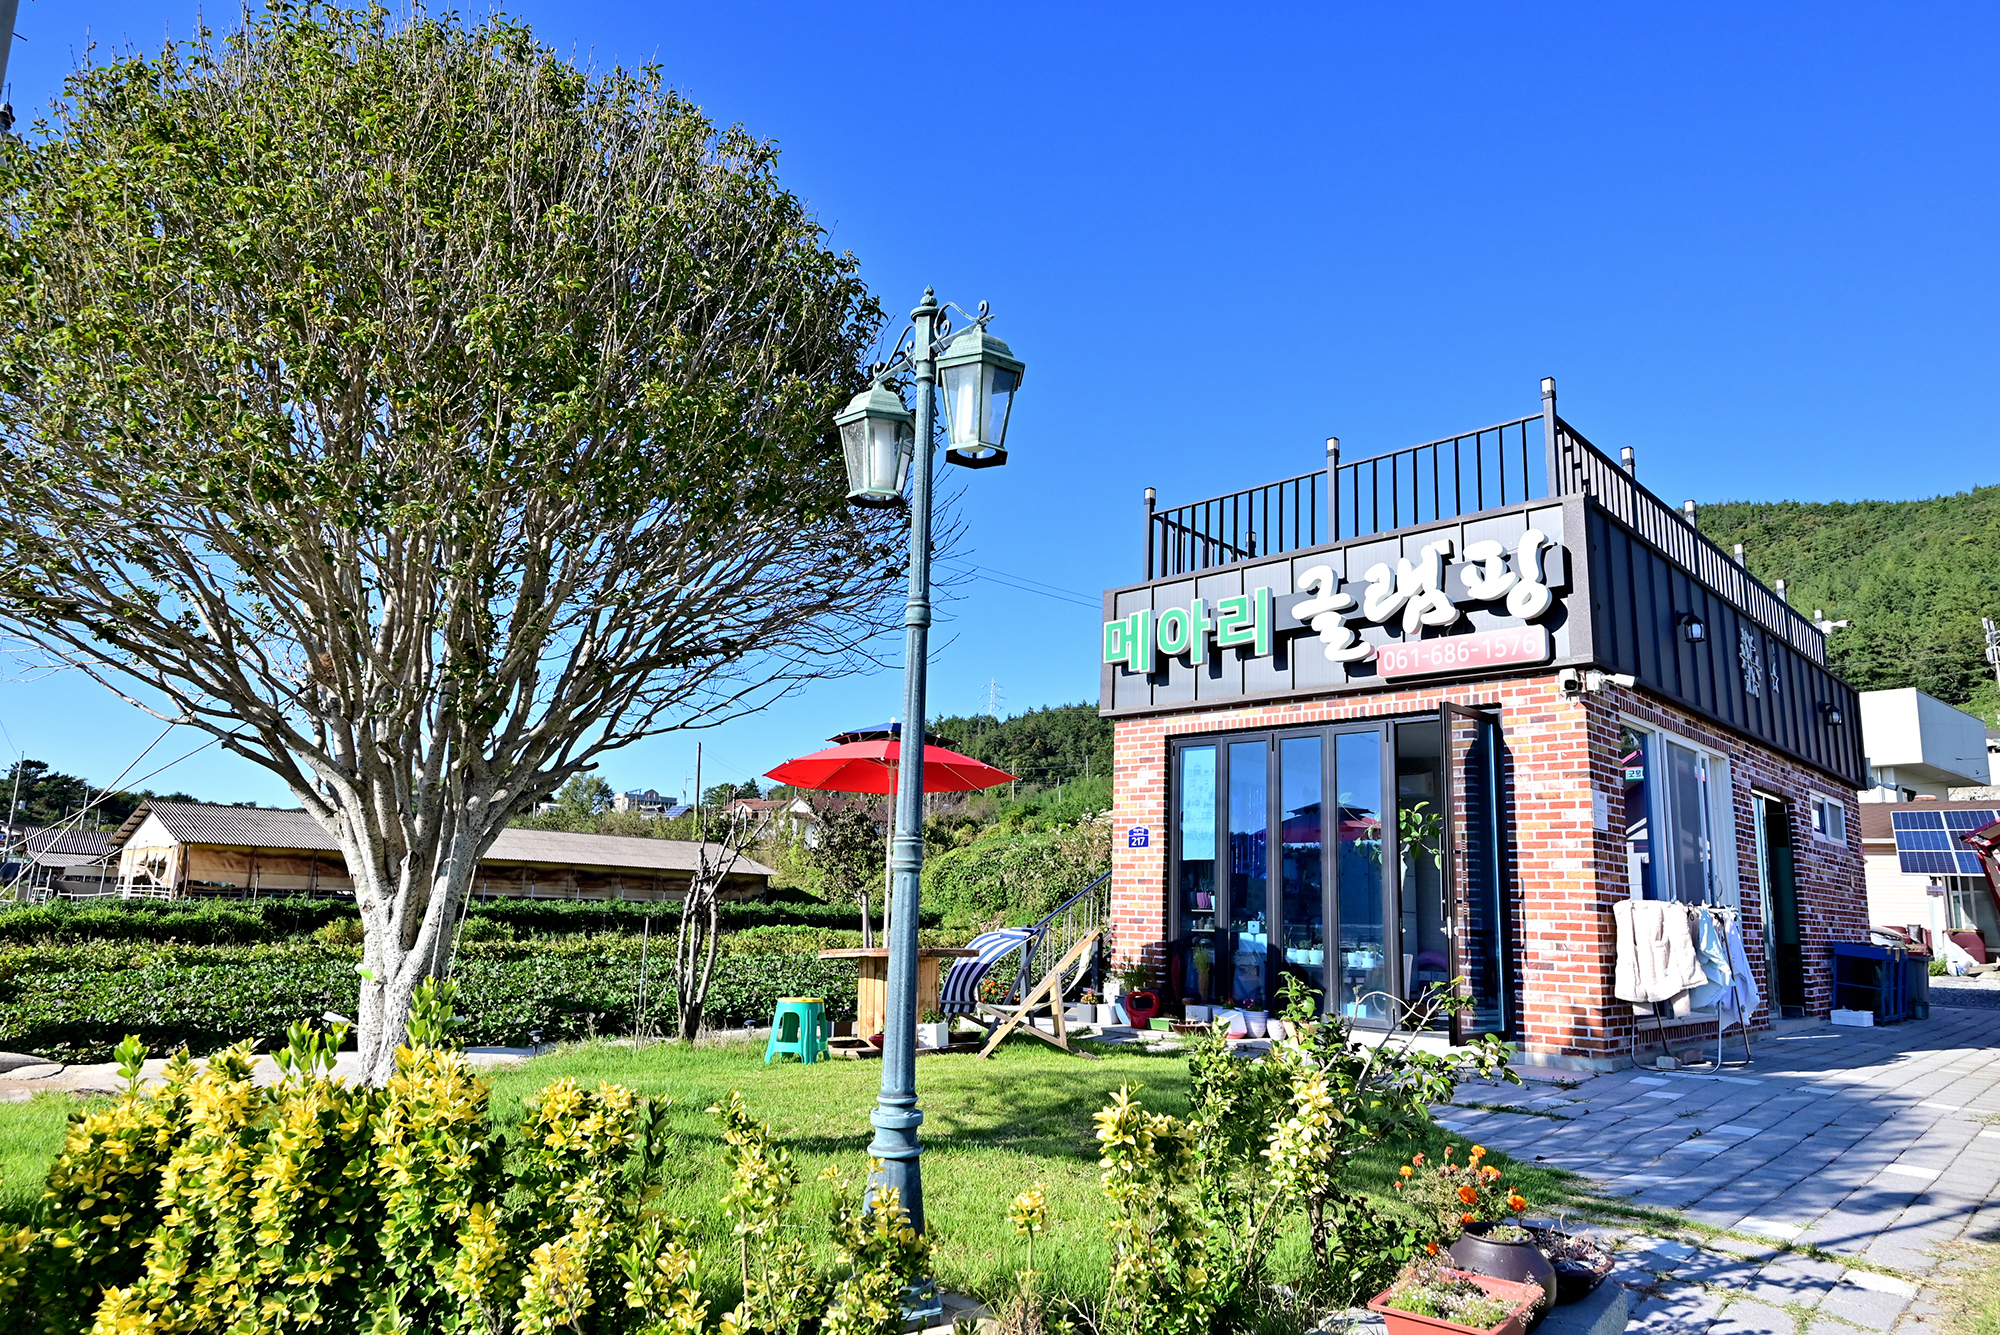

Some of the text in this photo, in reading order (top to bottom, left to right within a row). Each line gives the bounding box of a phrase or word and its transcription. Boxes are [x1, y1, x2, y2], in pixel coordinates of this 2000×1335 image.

[1103, 528, 1551, 673] 메아리 글램핑
[1383, 632, 1537, 672] 061-686-1576
[1131, 836, 1145, 846] 217
